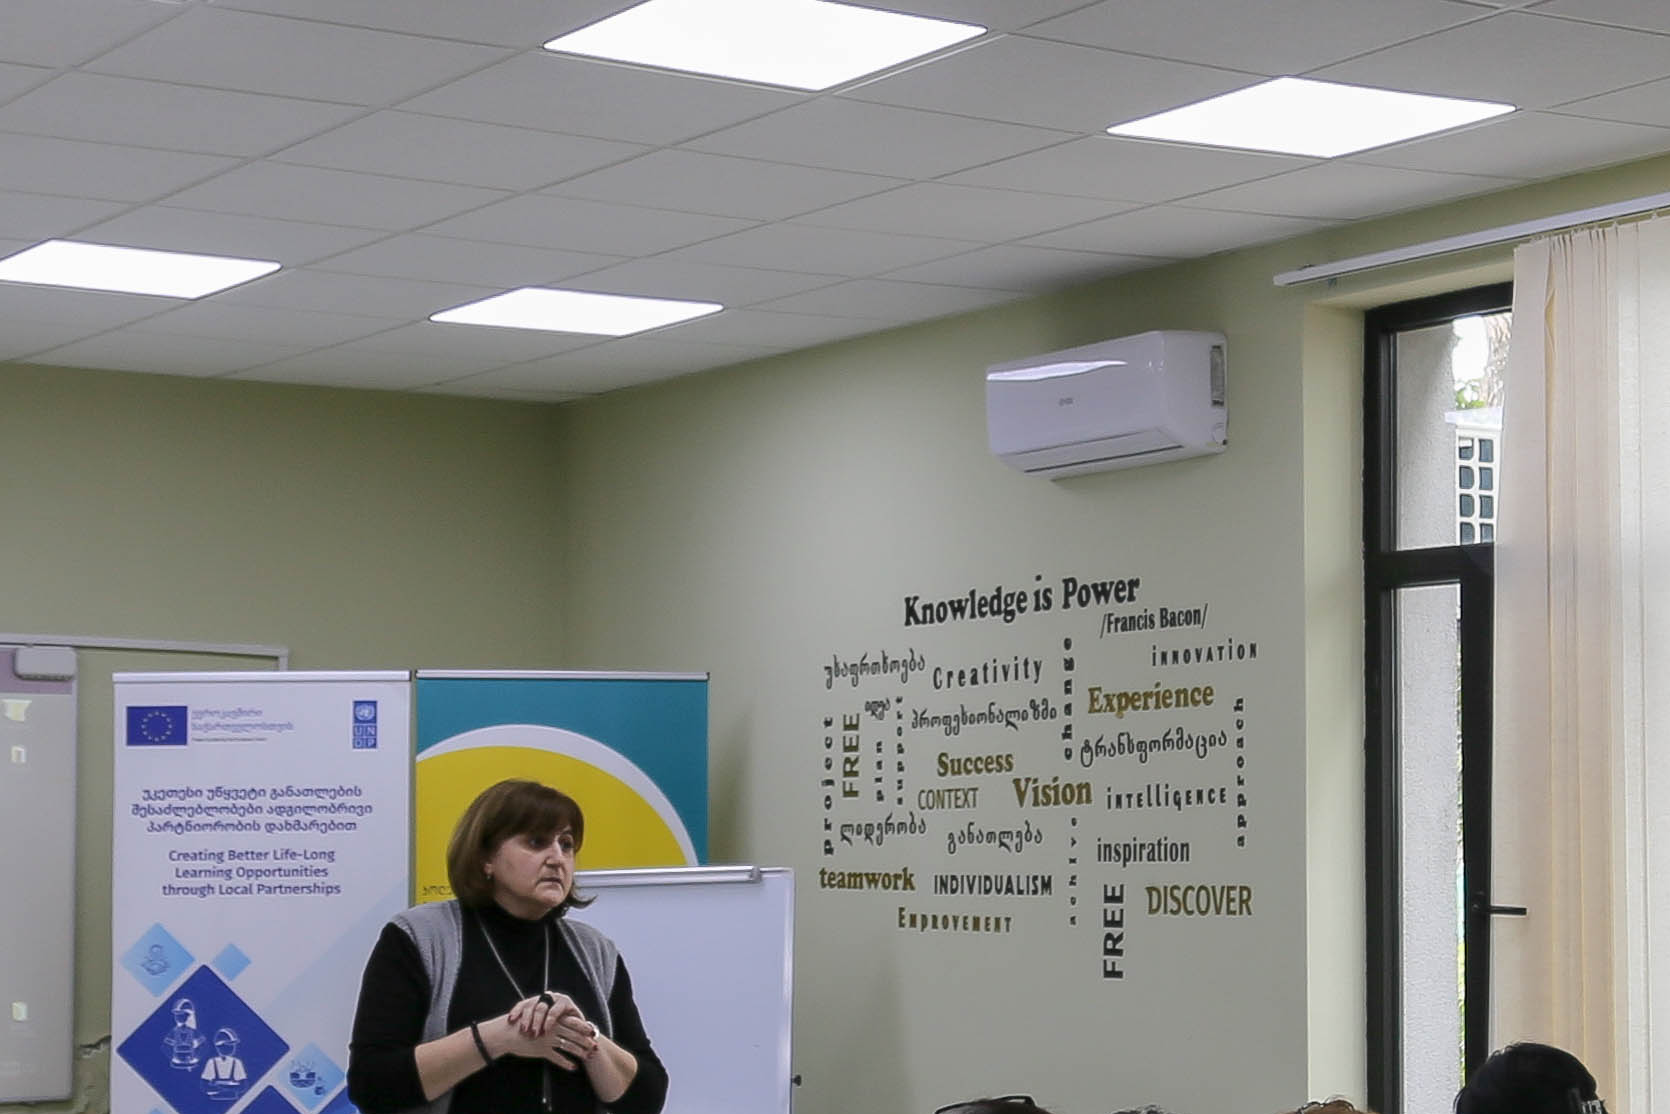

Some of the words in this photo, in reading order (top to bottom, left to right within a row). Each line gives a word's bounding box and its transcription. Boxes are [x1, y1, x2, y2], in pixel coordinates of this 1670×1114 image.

[903, 585, 1027, 626] Knowledge
[1033, 575, 1053, 612] is
[1062, 576, 1141, 610] Power
[1100, 608, 1156, 639] /Francis
[1159, 604, 1209, 630] Bacon/
[933, 656, 1043, 690] Creativity
[1061, 638, 1075, 761] change
[1087, 682, 1215, 719] Experience
[911, 698, 1058, 737] პროფესიონალიზმი
[842, 713, 860, 798] FREE
[895, 696, 905, 805] support
[937, 752, 1014, 777] Success
[1080, 726, 1228, 769] ტრანსფორმაცია
[821, 717, 835, 855] project
[874, 740, 885, 802] plan
[1234, 698, 1247, 847] approach
[142, 786, 203, 801] უკეთესი
[207, 786, 267, 801] უწყვეტი
[270, 785, 362, 800] განათლების
[917, 787, 979, 811] CONTEXT
[1012, 776, 1093, 808] Vision
[131, 803, 263, 817] შესაძლებლობები
[266, 802, 373, 816] ადგილობრივი
[146, 821, 261, 835] პარტნიორობის
[264, 820, 357, 834] დახმარებით
[839, 811, 927, 847] ლიდერობა
[947, 820, 1043, 855] განათლება
[168, 849, 225, 864] Creating
[228, 850, 269, 861] Better
[273, 848, 335, 863] Life-Long
[1097, 836, 1190, 868] inspiration
[162, 884, 215, 898] through
[219, 883, 253, 895] Local
[257, 882, 341, 897] Partnerships
[175, 866, 232, 881] Learning
[236, 866, 329, 880] Opportunities
[818, 866, 916, 891] teamwork
[934, 874, 1053, 896] INDIVIDUALISM
[1145, 884, 1252, 916] DISCOVER
[1103, 883, 1125, 980] FREE
